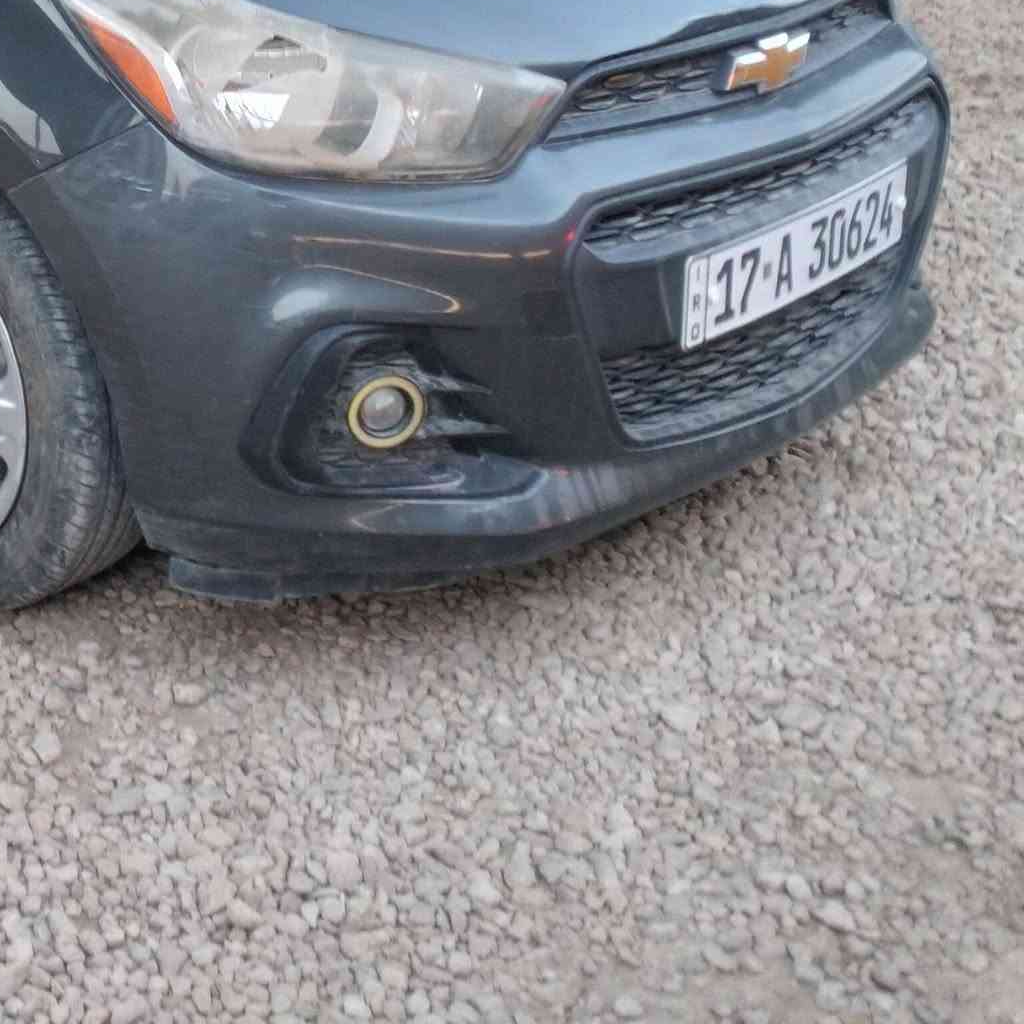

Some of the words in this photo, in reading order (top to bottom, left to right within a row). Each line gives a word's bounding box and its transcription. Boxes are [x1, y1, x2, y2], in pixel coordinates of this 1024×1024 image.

[714, 247, 761, 326] 17
[775, 233, 793, 299] A
[808, 181, 893, 280] 30624
